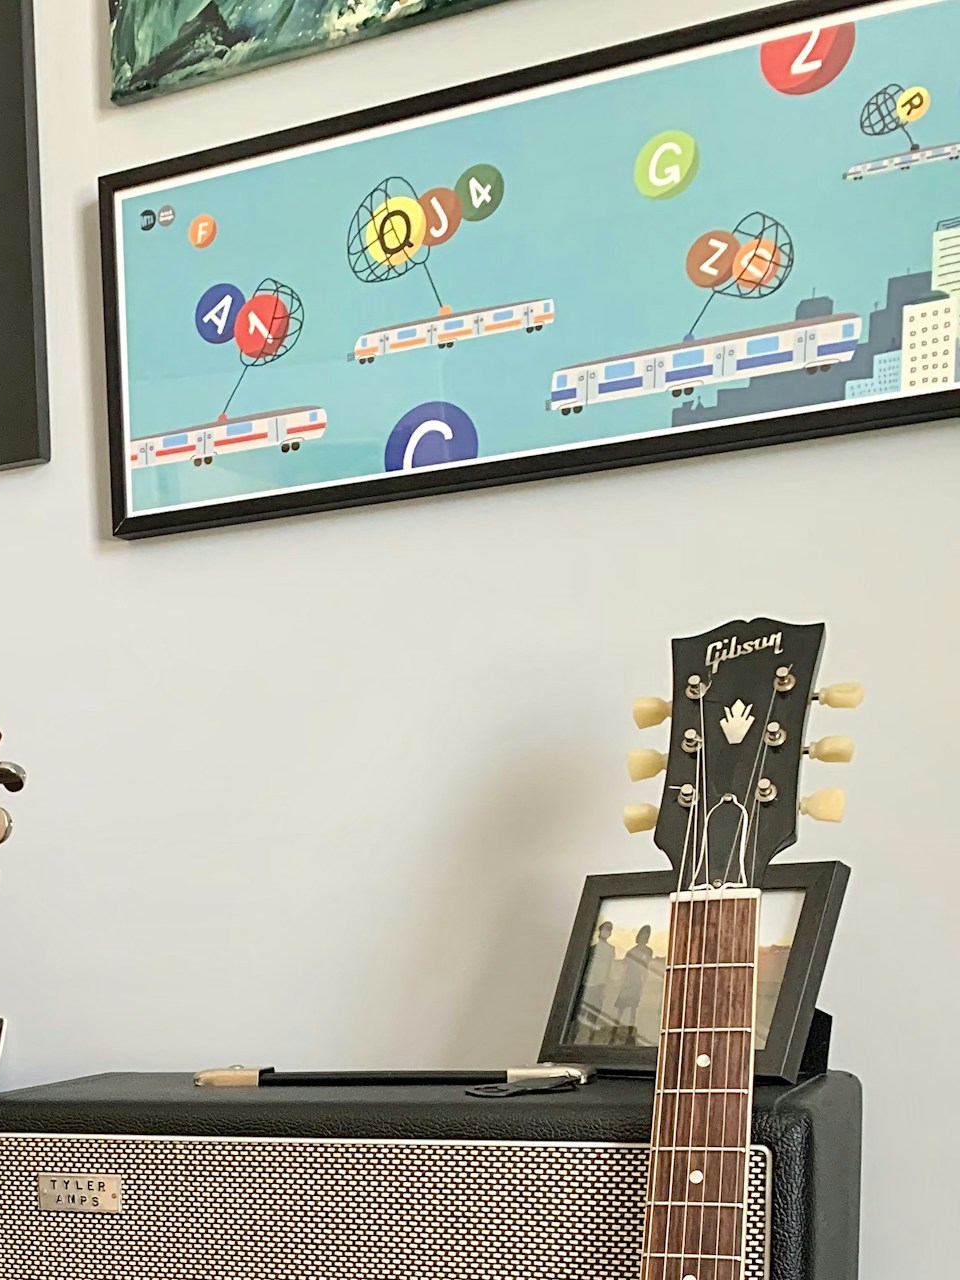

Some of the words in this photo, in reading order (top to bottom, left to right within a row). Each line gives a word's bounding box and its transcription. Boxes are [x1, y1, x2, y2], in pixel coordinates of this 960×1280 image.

[901, 92, 924, 116] R
[648, 142, 682, 187] G
[197, 222, 209, 243] F
[379, 209, 414, 255] Q
[430, 196, 449, 238] J
[469, 177, 492, 209] 4
[202, 294, 233, 335] A
[248, 311, 274, 344] 1
[704, 631, 784, 674] Gibson
[49, 1179, 106, 1192] TYLER
[55, 1194, 100, 1207] AMPS
